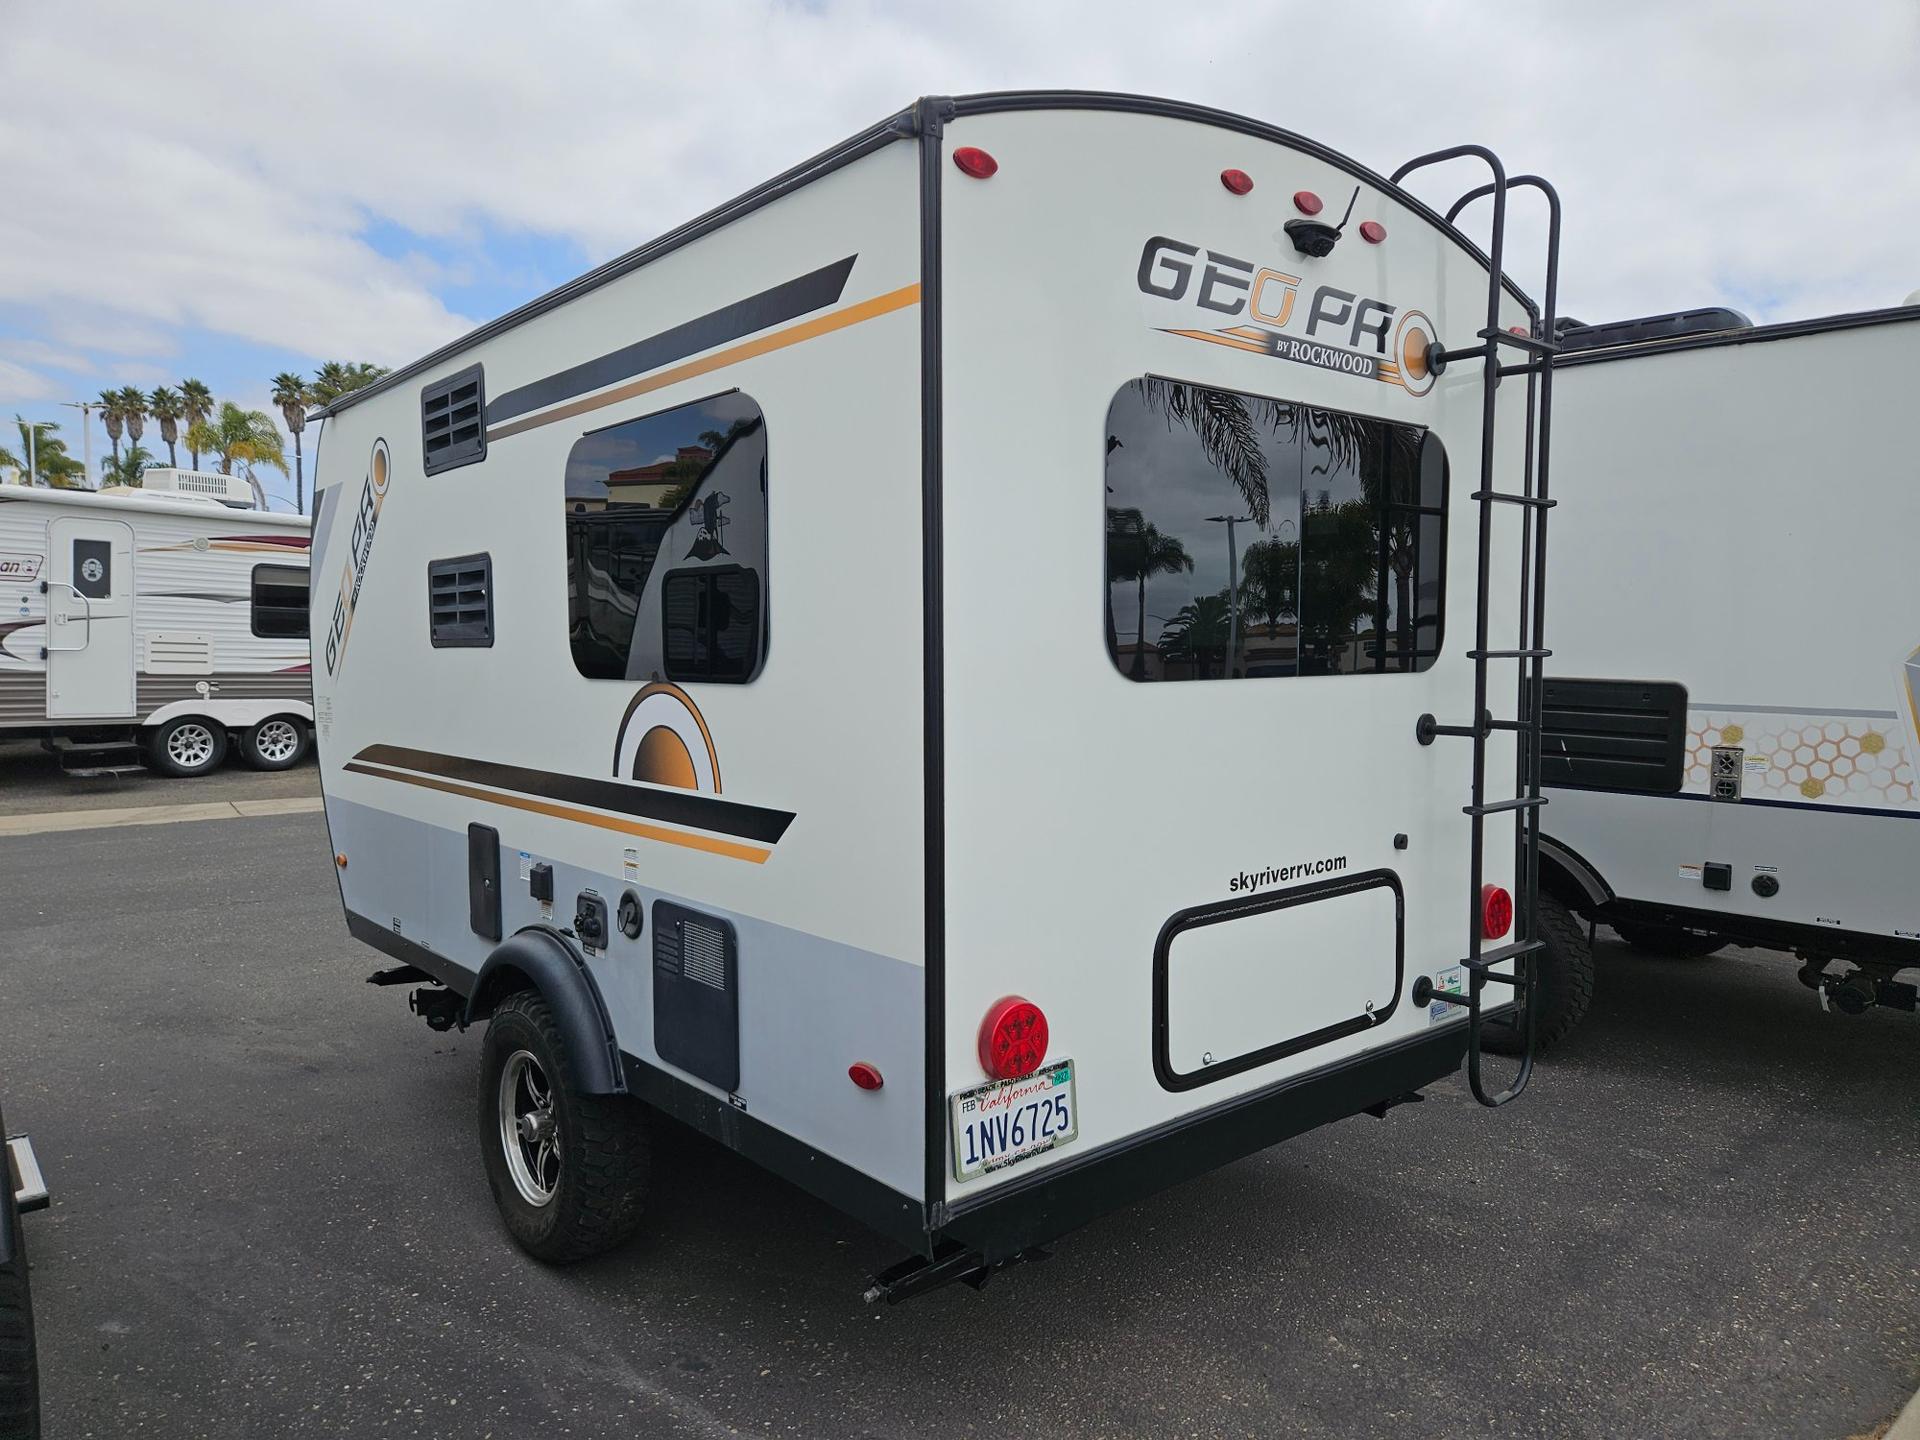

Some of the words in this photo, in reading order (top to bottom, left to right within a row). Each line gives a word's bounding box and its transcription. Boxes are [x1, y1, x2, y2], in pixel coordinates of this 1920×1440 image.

[1137, 235, 1302, 328] GEO
[1277, 340, 1290, 352] BY
[1290, 340, 1373, 375] ROCKWOOD
[1229, 856, 1347, 893] skyriverrv.com
[962, 1100, 976, 1113] FEB
[980, 1080, 1054, 1112] California
[966, 1093, 1069, 1165] 1NV6725
